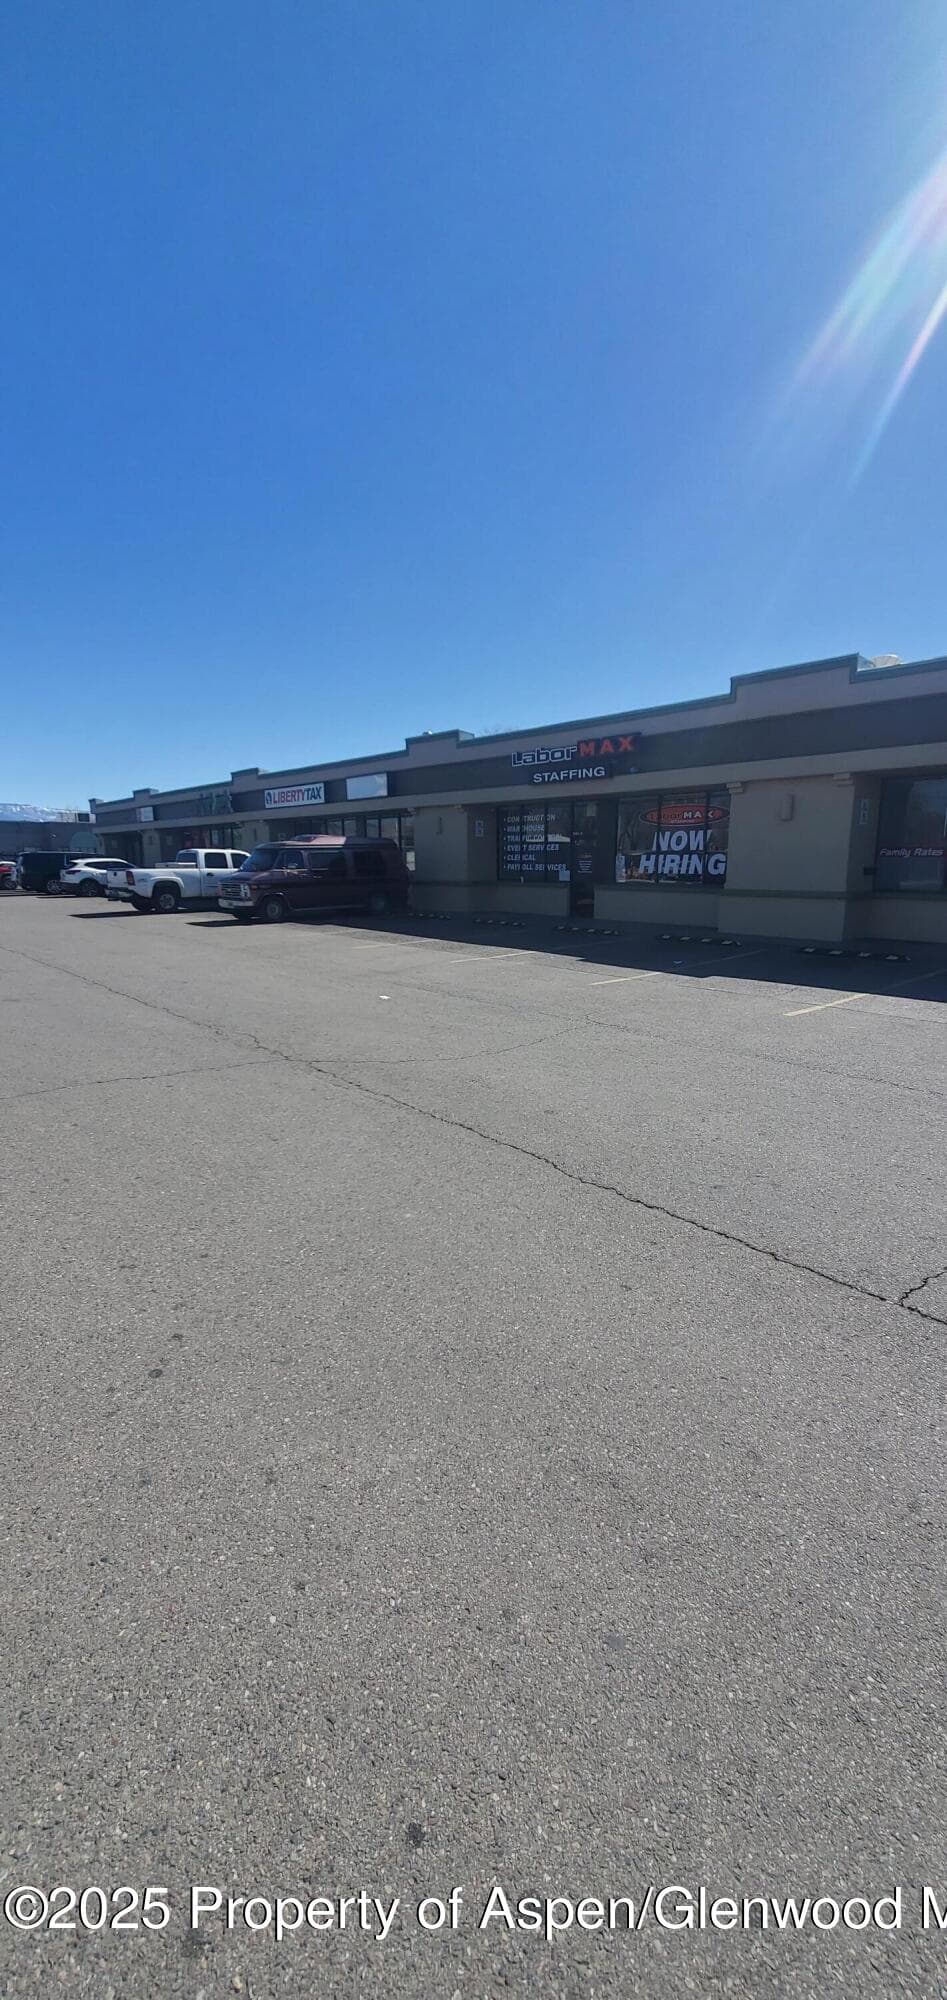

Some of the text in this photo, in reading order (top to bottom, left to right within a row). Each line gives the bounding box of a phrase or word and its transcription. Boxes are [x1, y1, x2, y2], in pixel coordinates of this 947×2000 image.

[533, 766, 606, 783] STAFFING
[507, 814, 556, 823] CONTRUCTON
[507, 824, 545, 833] WARHOUSE
[651, 829, 713, 852] NOW
[528, 843, 560, 851] SERVCES
[880, 847, 945, 858] Family Rates
[639, 853, 727, 876] HIRING
